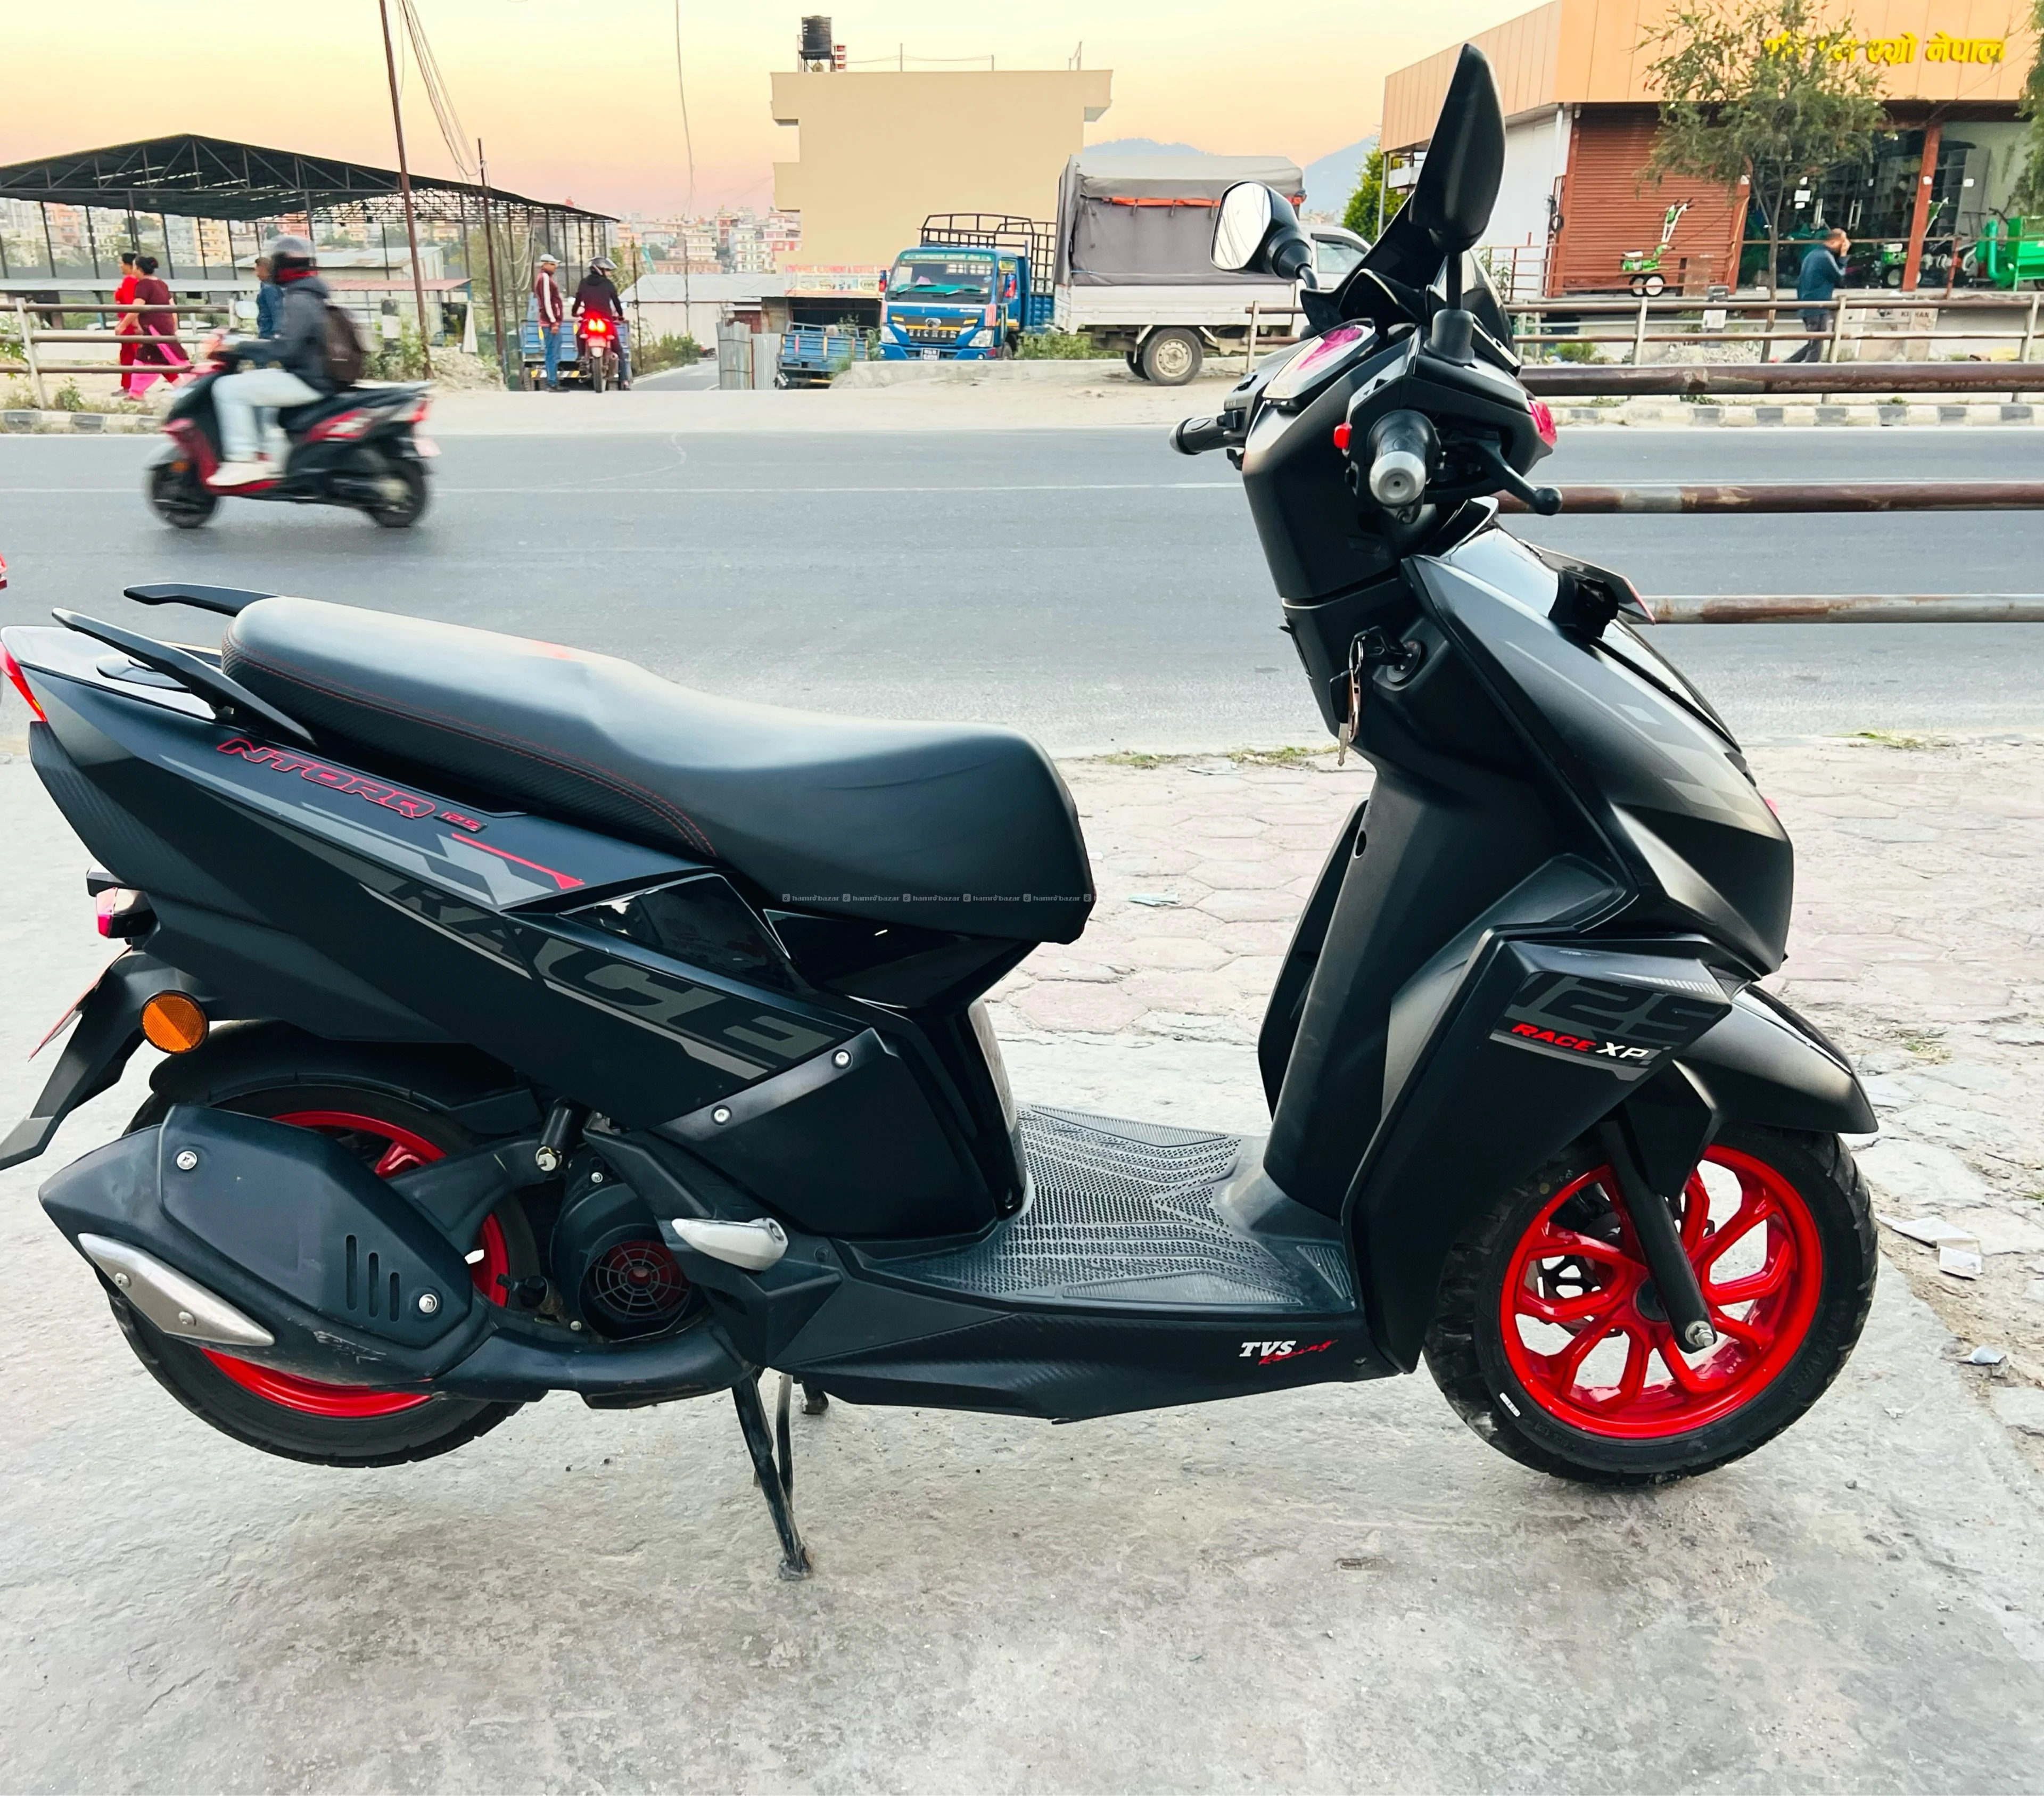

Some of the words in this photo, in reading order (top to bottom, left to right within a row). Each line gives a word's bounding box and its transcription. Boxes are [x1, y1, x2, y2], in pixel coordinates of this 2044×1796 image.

[1925, 30, 2005, 64] नेपाल
[217, 737, 435, 819] NTORQ
[440, 811, 481, 831] 125
[1511, 1023, 1596, 1052] RACE
[1595, 1042, 1650, 1059] XP
[1239, 1340, 1297, 1357] TVS
